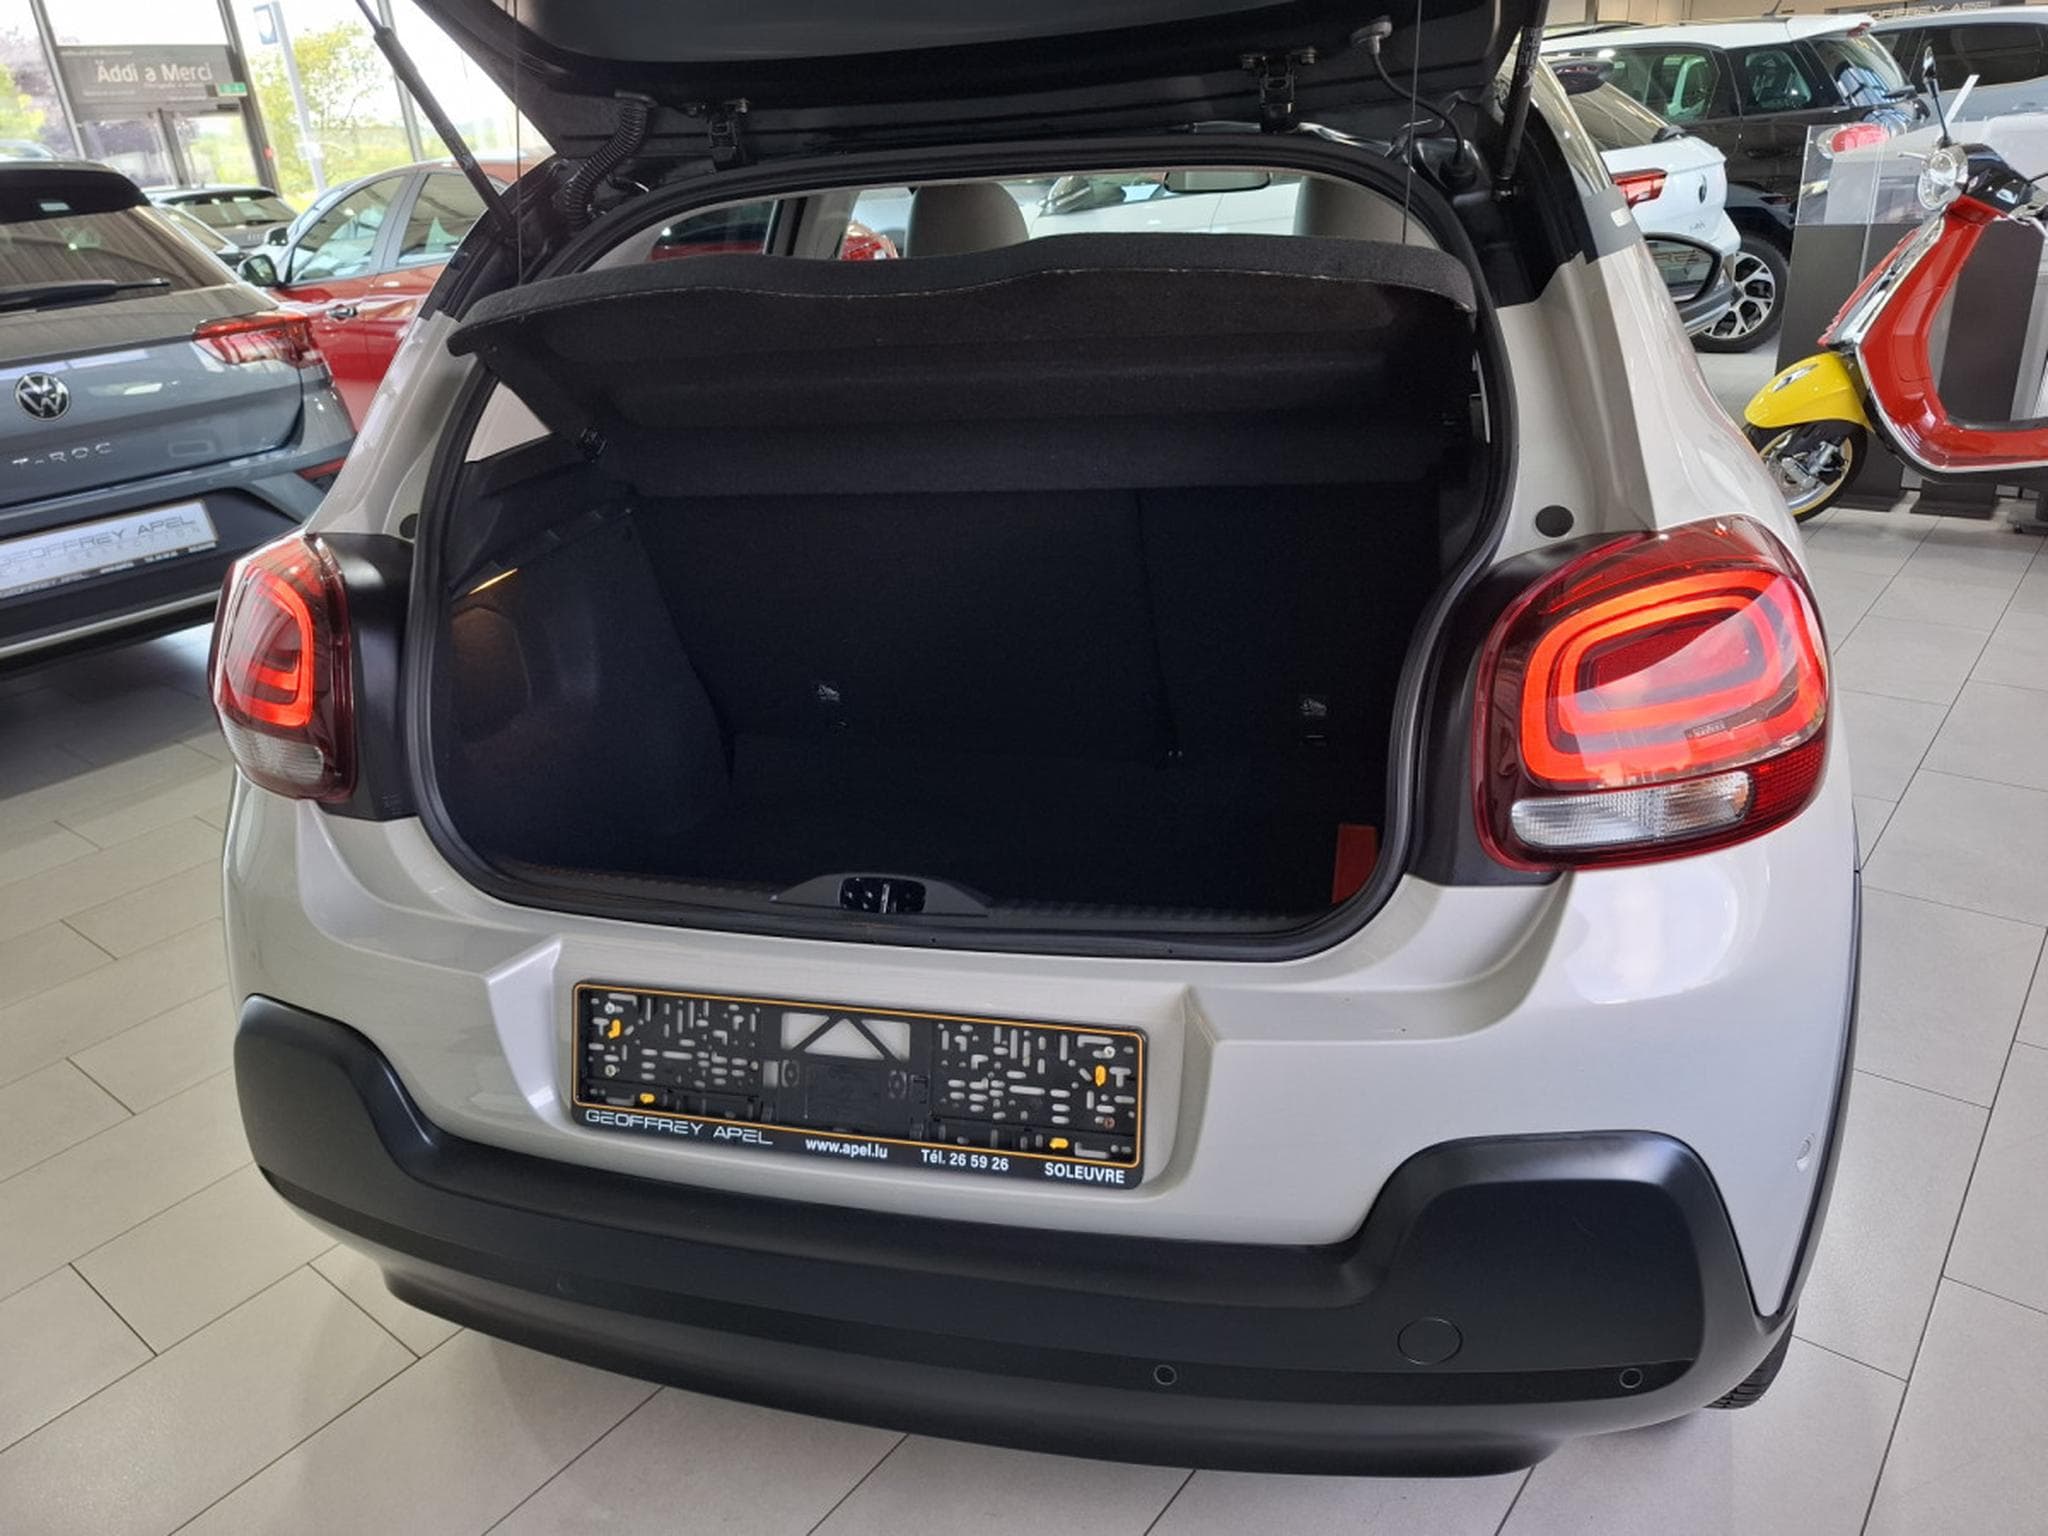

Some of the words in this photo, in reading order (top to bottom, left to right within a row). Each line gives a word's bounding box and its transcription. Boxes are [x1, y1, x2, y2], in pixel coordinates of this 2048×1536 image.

[95, 60, 139, 82] Äddi
[144, 66, 156, 82] a
[160, 62, 213, 82] Merci
[137, 515, 196, 536] APEL
[585, 1109, 703, 1135] GEOFFREY
[713, 1125, 773, 1145] APEL
[805, 1139, 888, 1159] www.apel.lu
[921, 1149, 946, 1165] Tél.
[949, 1152, 966, 1167] 26
[970, 1154, 988, 1169] 59
[991, 1156, 1009, 1171] 26
[1044, 1162, 1125, 1184] SOLEUVRE
